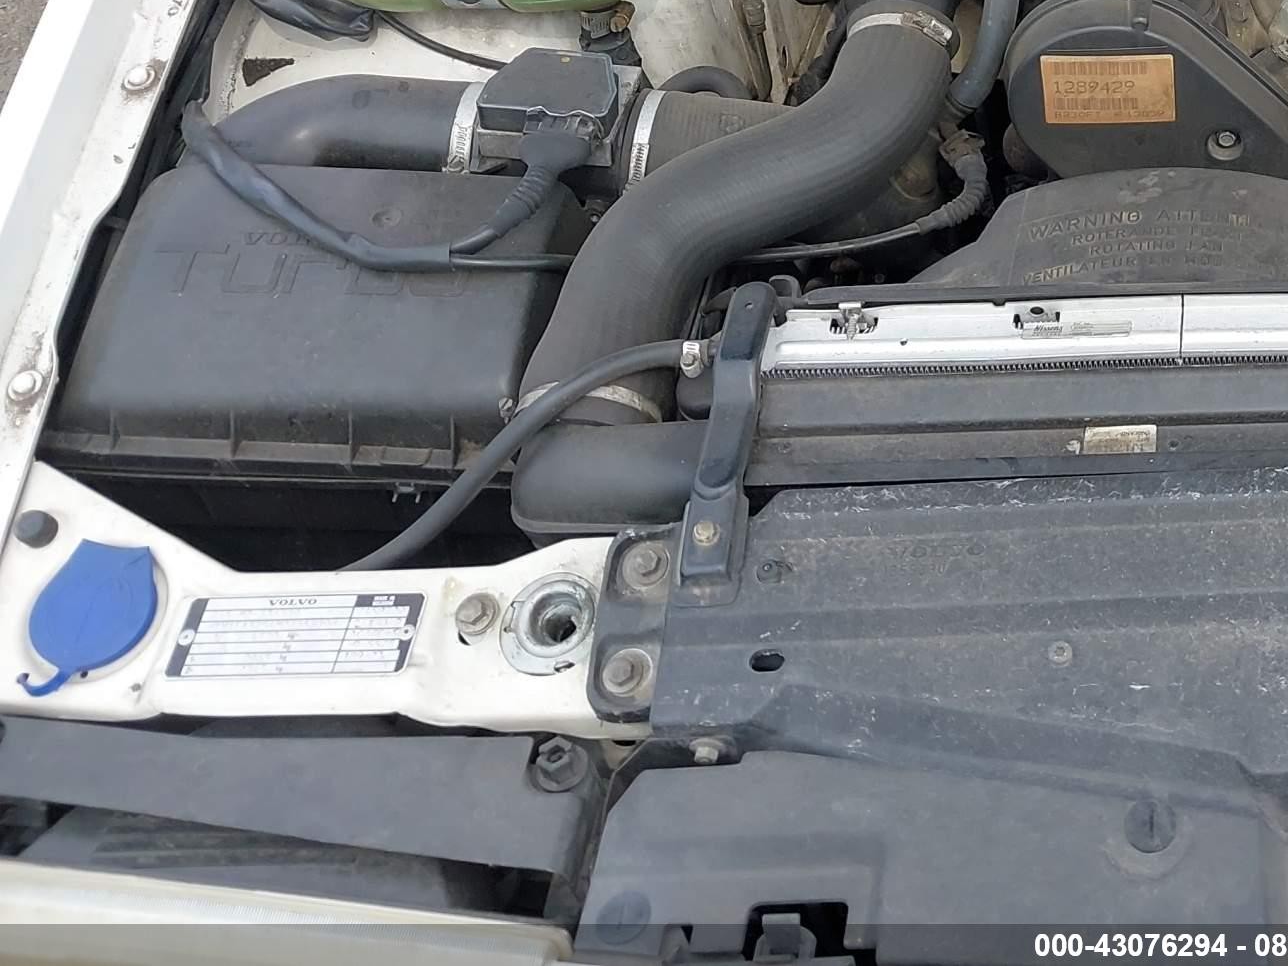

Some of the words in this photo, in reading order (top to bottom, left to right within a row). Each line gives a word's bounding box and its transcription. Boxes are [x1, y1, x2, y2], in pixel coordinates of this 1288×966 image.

[1053, 80, 1136, 95] 1289429
[1029, 210, 1143, 242] WARNING
[268, 598, 318, 607] VOLVO
